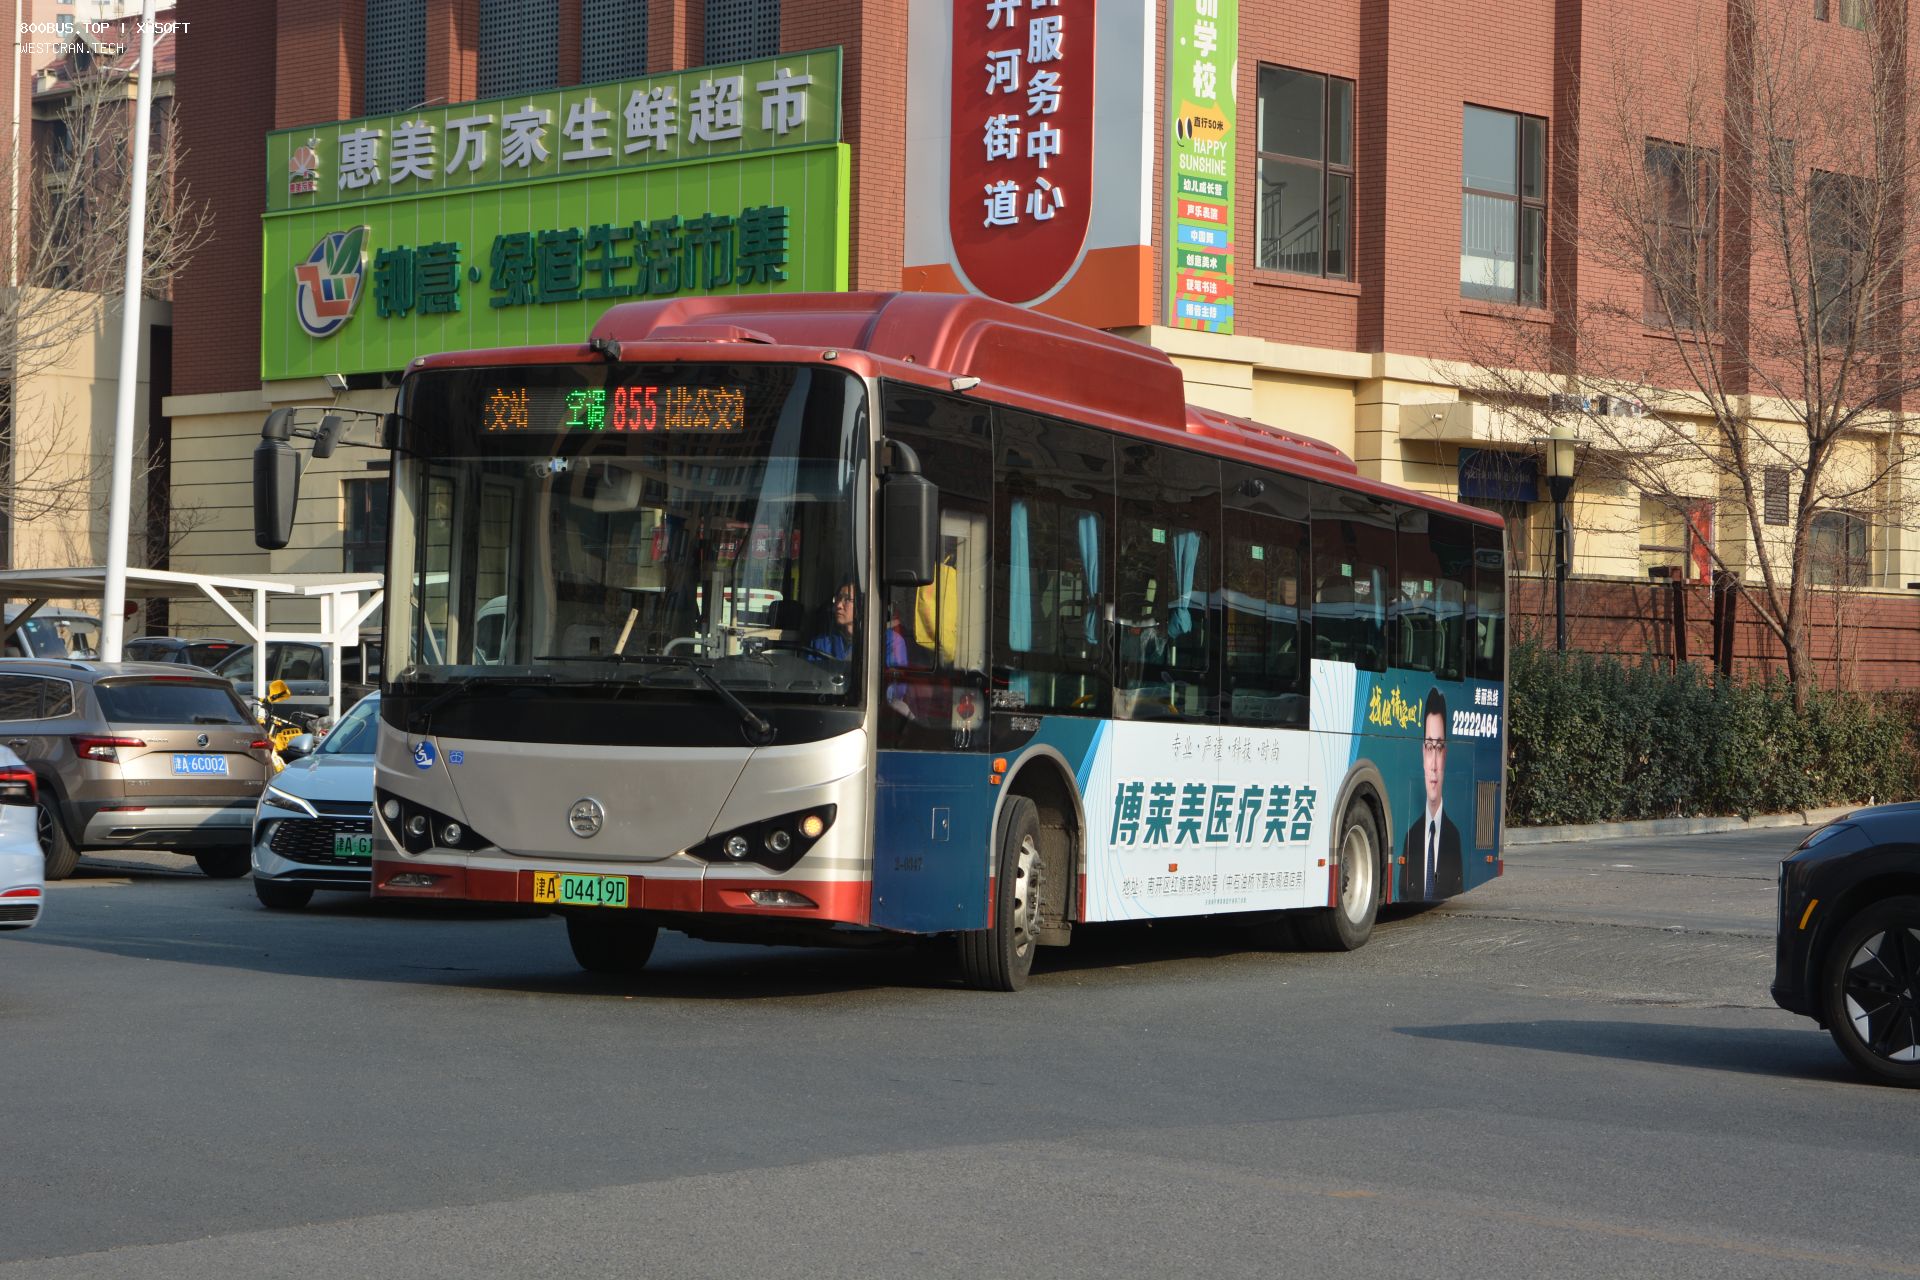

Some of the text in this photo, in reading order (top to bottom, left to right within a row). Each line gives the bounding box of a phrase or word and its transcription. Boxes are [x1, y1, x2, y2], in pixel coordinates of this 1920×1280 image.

[1025, 0, 1065, 221] 服务中心
[1194, 116, 1224, 131] 直行50米
[337, 67, 813, 191] 惠美万家生鲜超市
[1194, 137, 1228, 157] HAPPY
[1179, 154, 1227, 176] SUNSHINE
[1187, 204, 1219, 221] 声乐表演
[566, 390, 606, 430] 空调
[613, 386, 658, 431] 855
[1452, 710, 1498, 738] 22222464
[1109, 781, 1318, 846] 博莱美医疗美容
